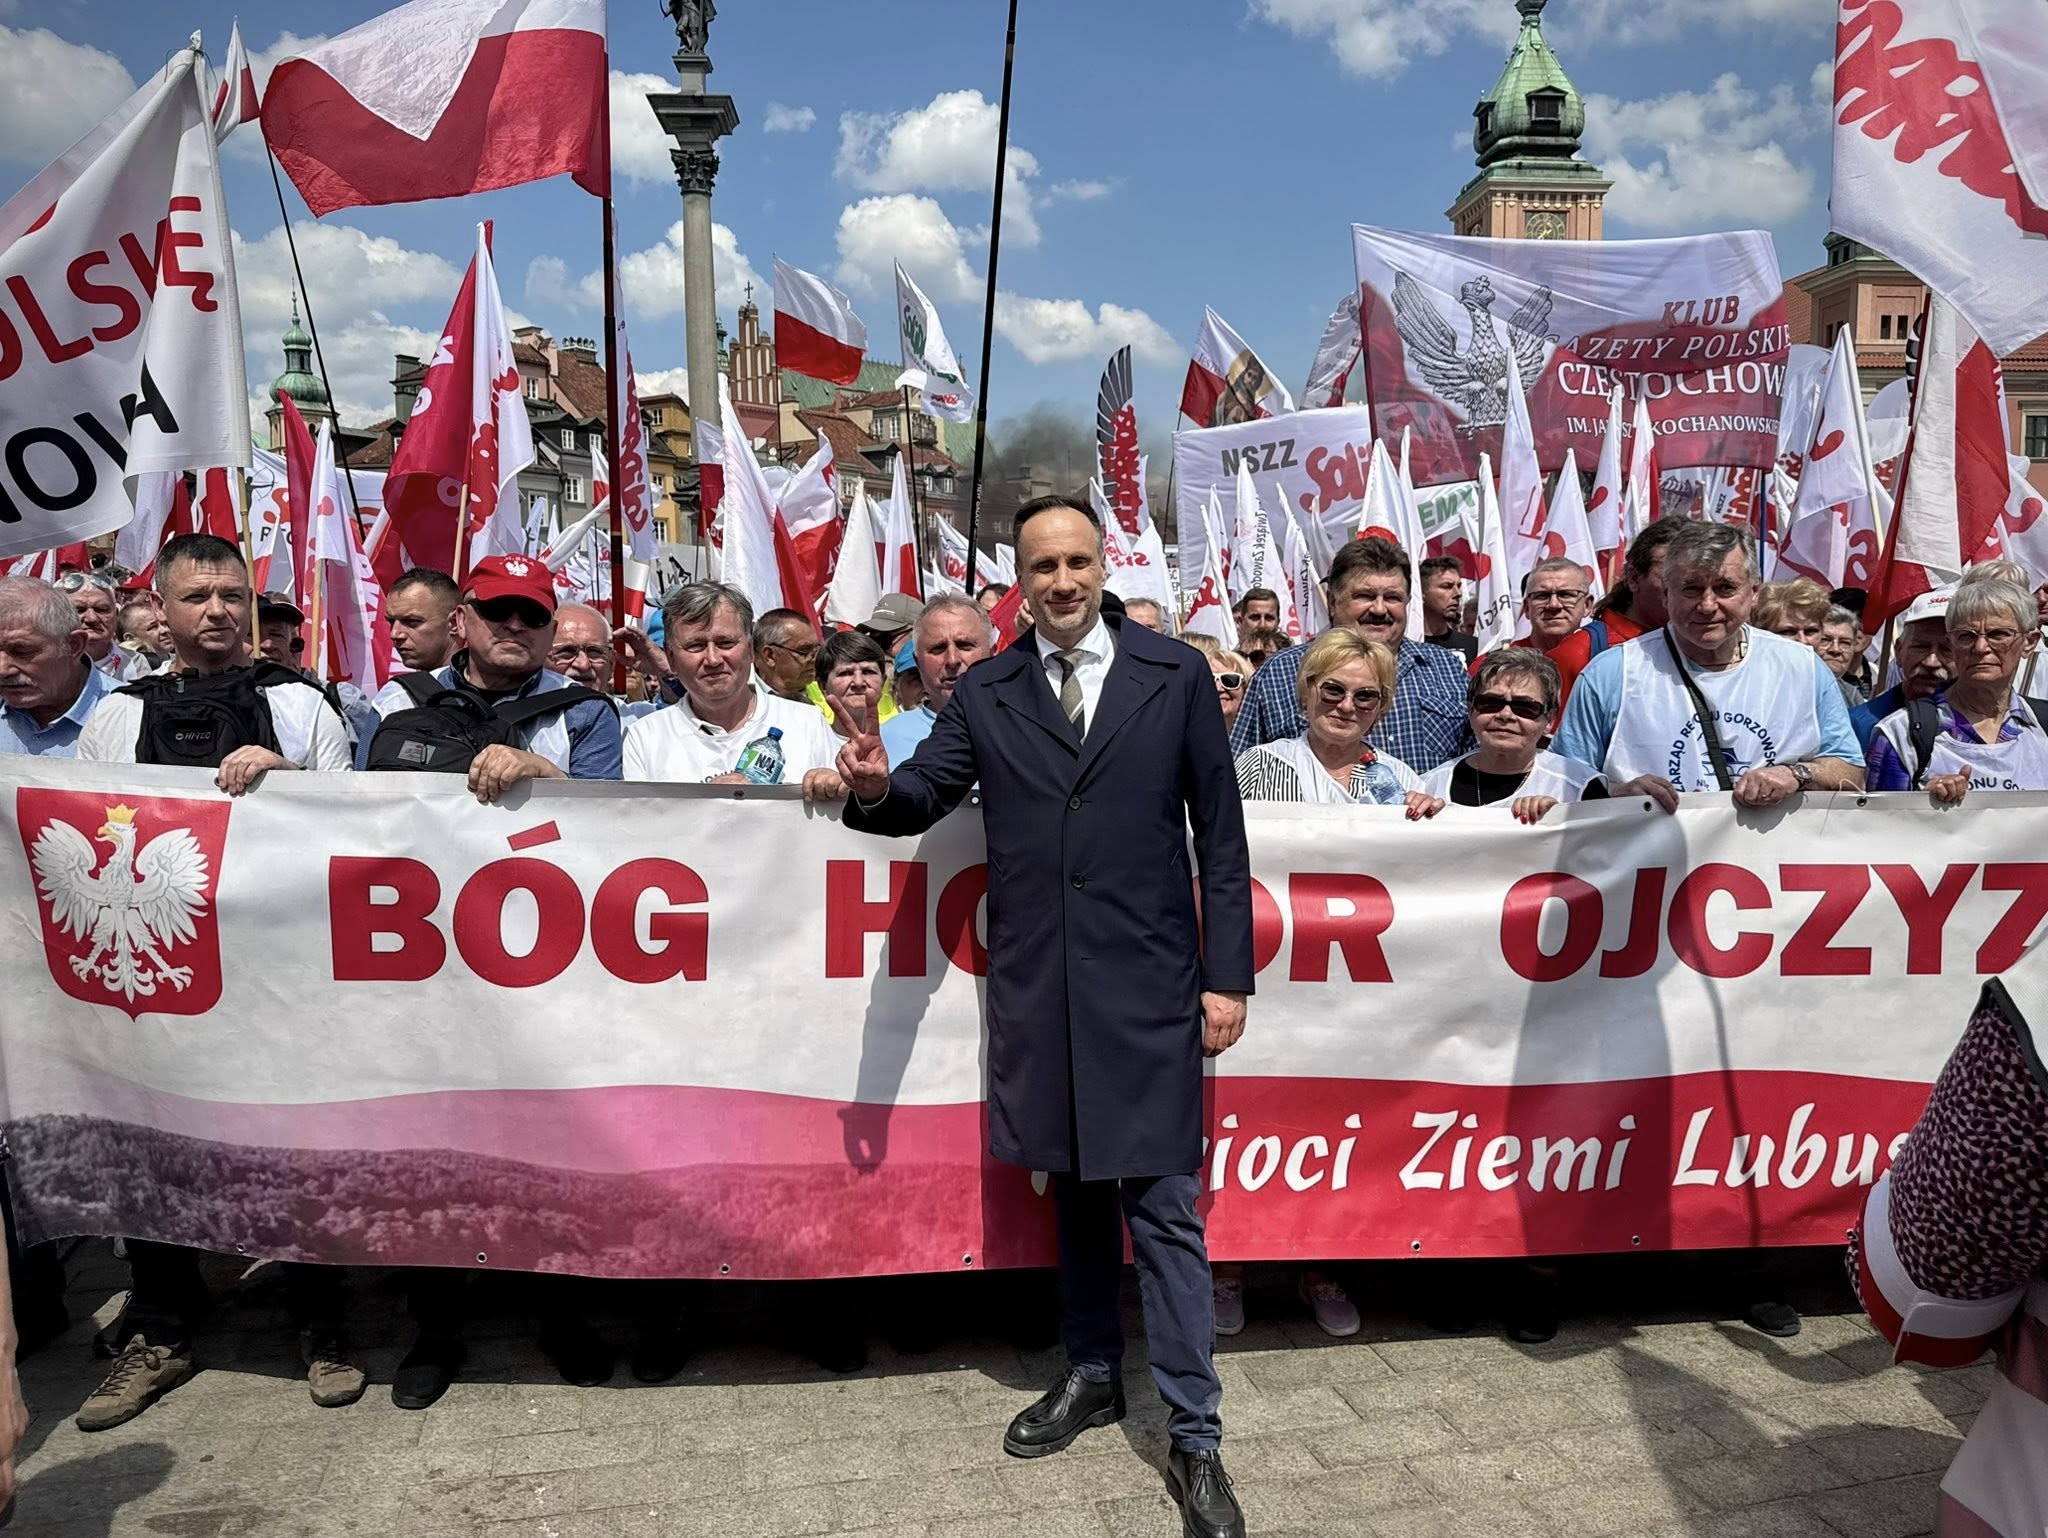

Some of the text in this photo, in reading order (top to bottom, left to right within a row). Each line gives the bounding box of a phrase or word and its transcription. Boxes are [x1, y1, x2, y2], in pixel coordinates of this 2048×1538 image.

[1661, 295, 1740, 328] KLUB
[1543, 334, 1676, 361] GAZETY
[1557, 361, 1787, 405] CZĘSTOCHOW
[1566, 416, 1592, 434] IM.
[1592, 417, 1633, 439] JASZ
[1221, 438, 1298, 477] NSZZ
[329, 820, 710, 989] BÓG
[1399, 1108, 1638, 1193] Ziemi
